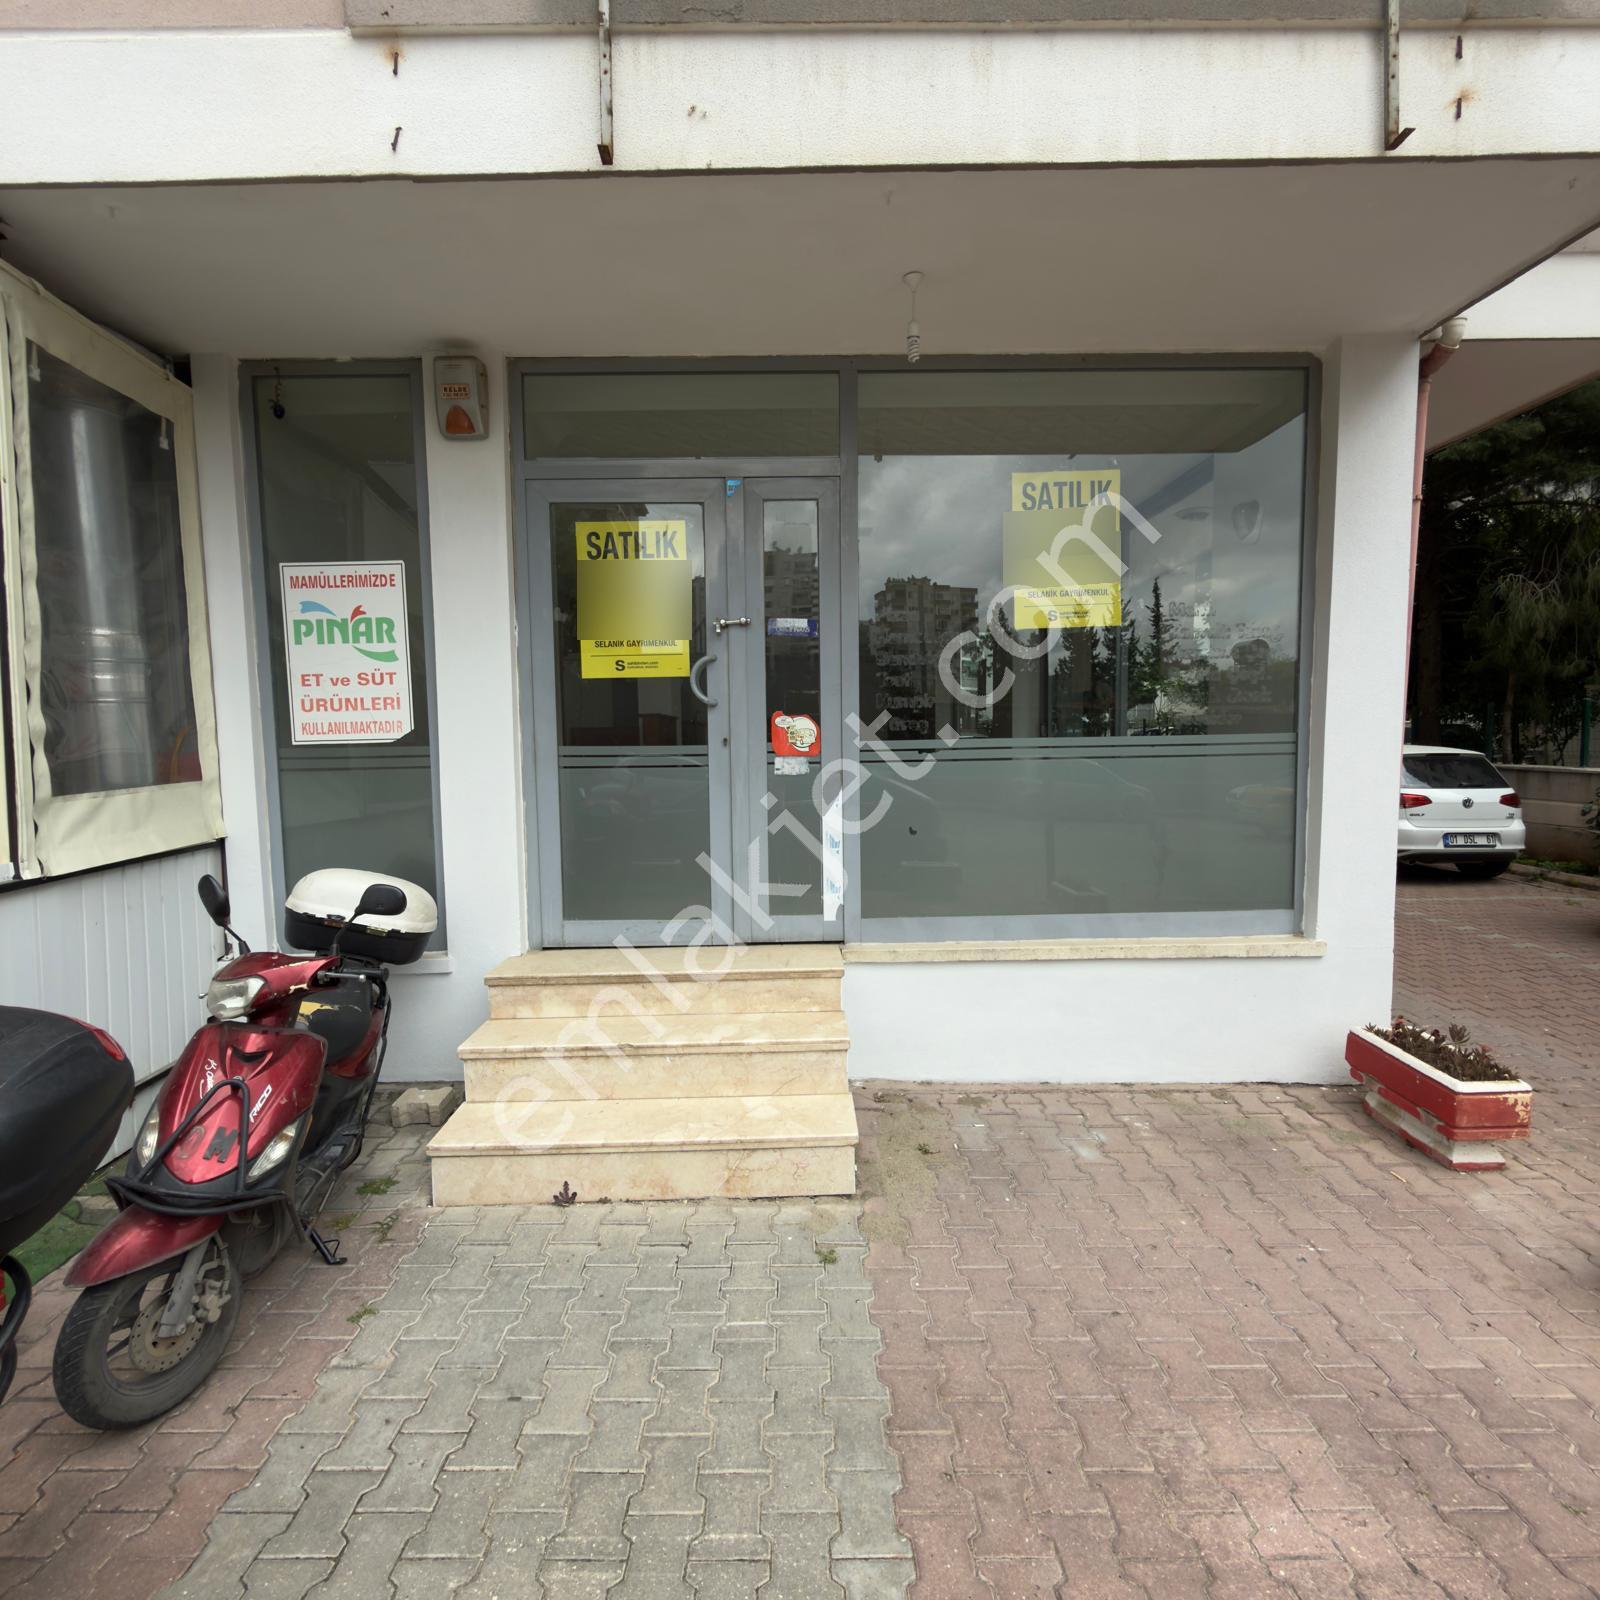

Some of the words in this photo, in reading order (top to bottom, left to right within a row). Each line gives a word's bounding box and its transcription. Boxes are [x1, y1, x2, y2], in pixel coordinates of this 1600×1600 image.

[1022, 480, 1112, 511] SATILIK
[586, 530, 680, 560] SATILIK
[289, 571, 397, 589] MAMÜLLERİMİZDE
[293, 616, 397, 645] PINAR
[301, 674, 324, 687] ET
[330, 676, 351, 687] ve
[357, 668, 397, 686] SÜT
[300, 693, 401, 712] ÜRÜNLERİ
[301, 720, 403, 735] KULLANILMAKTADIR
